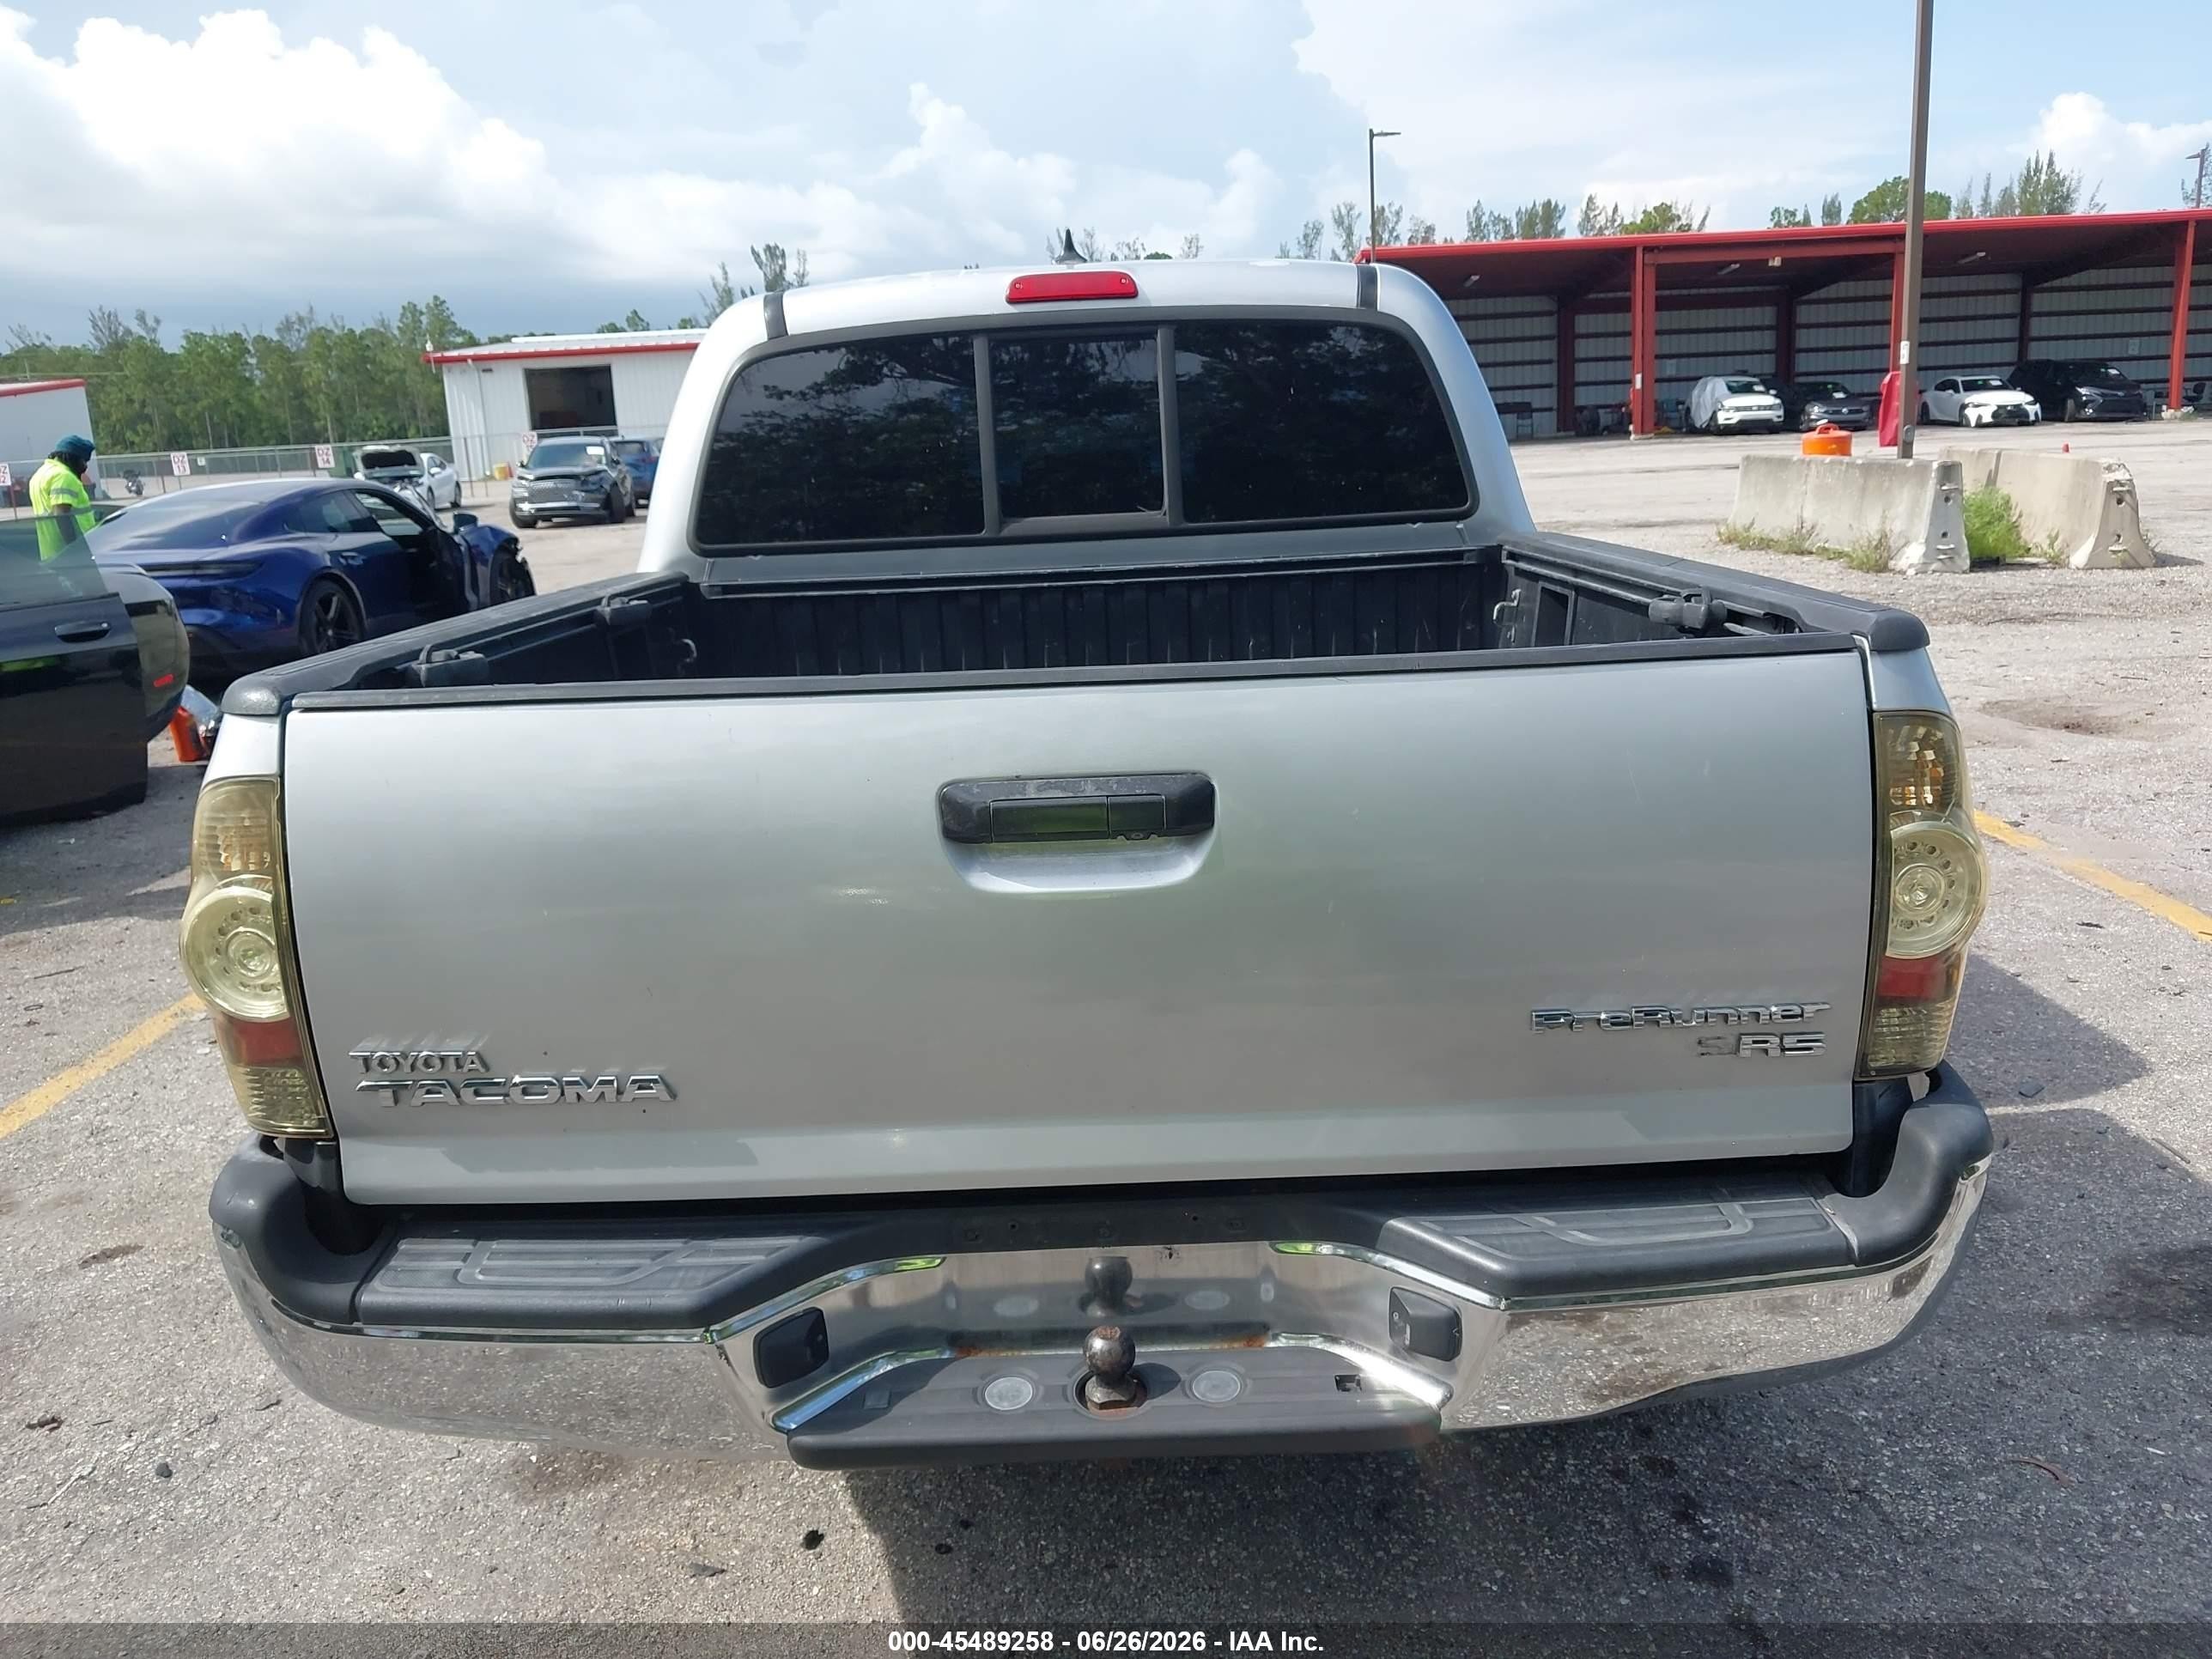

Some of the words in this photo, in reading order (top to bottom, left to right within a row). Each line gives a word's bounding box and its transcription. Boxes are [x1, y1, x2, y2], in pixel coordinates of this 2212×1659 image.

[173, 455, 185, 464] DZ
[317, 447, 331, 457] DZ
[0, 465, 8, 474] Z
[1532, 1002, 1831, 1032] PreRunner
[349, 1051, 488, 1073] TOYOTA
[356, 1075, 677, 1107] TACOMA
